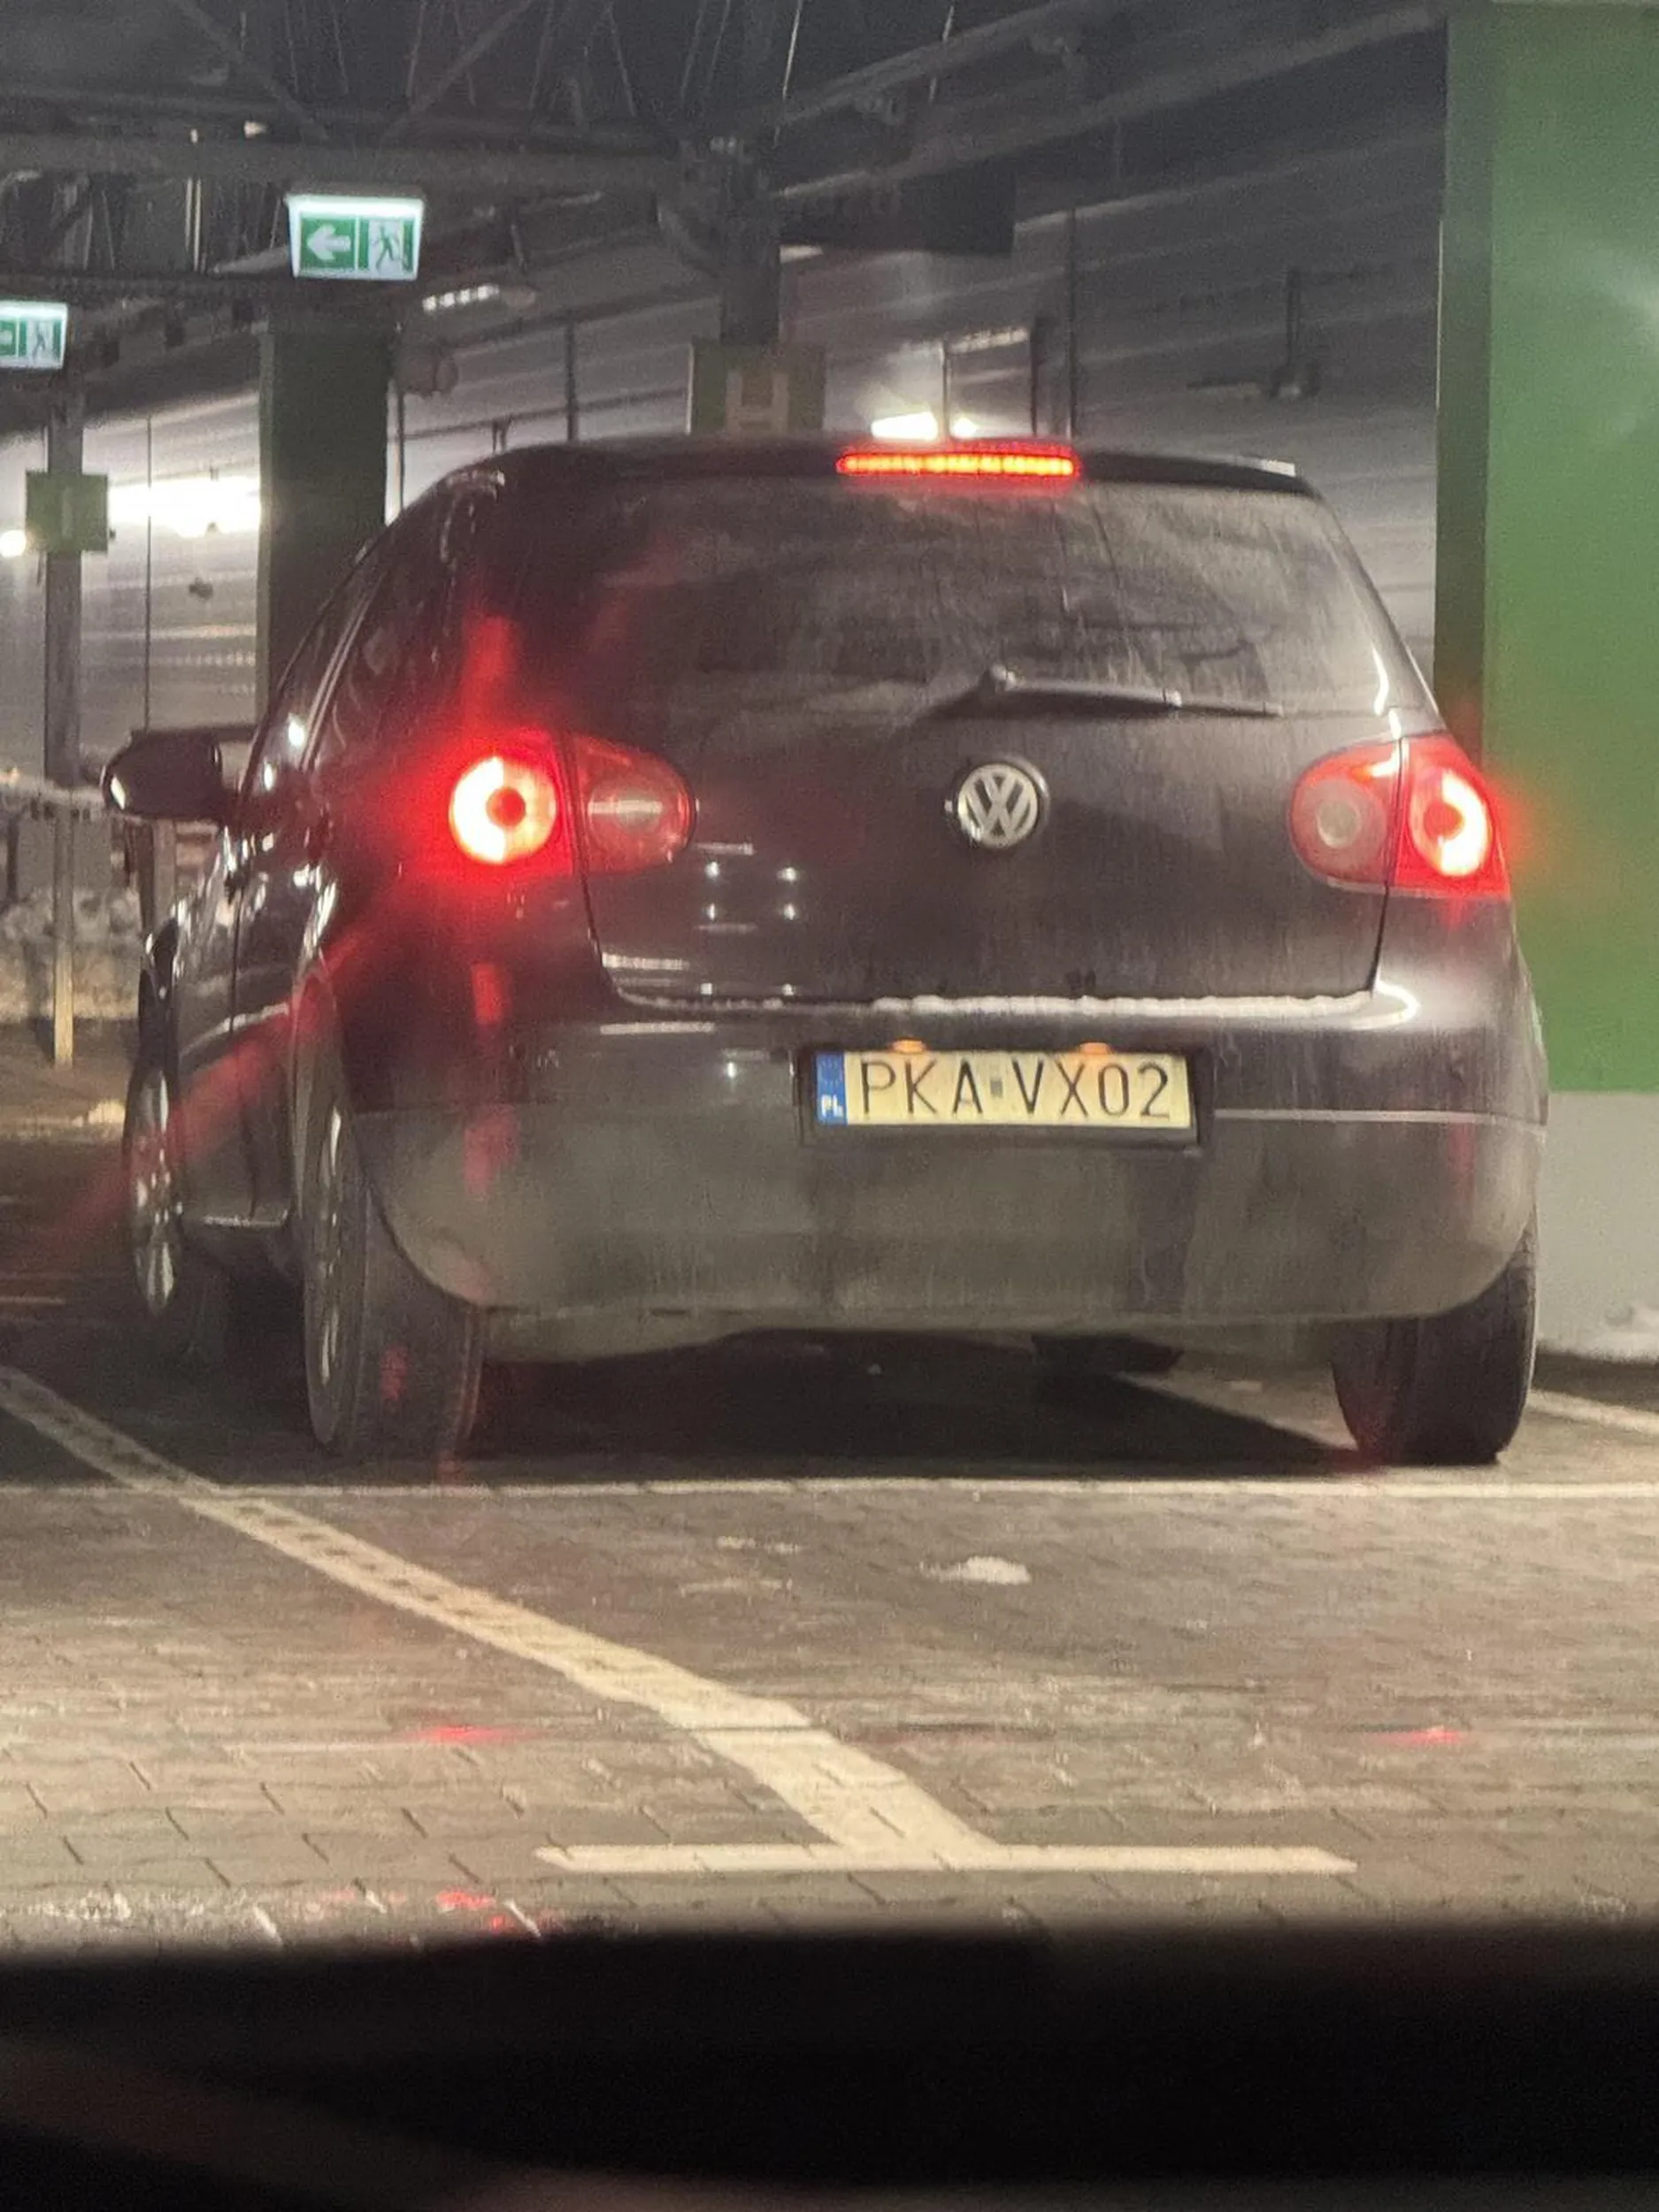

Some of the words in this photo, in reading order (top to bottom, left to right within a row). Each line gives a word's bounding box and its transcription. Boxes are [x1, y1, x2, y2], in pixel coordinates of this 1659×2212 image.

[959, 764, 1037, 847] VW
[821, 1094, 844, 1118] PL
[860, 1059, 983, 1115] PKA
[1011, 1059, 1170, 1119] VX02
